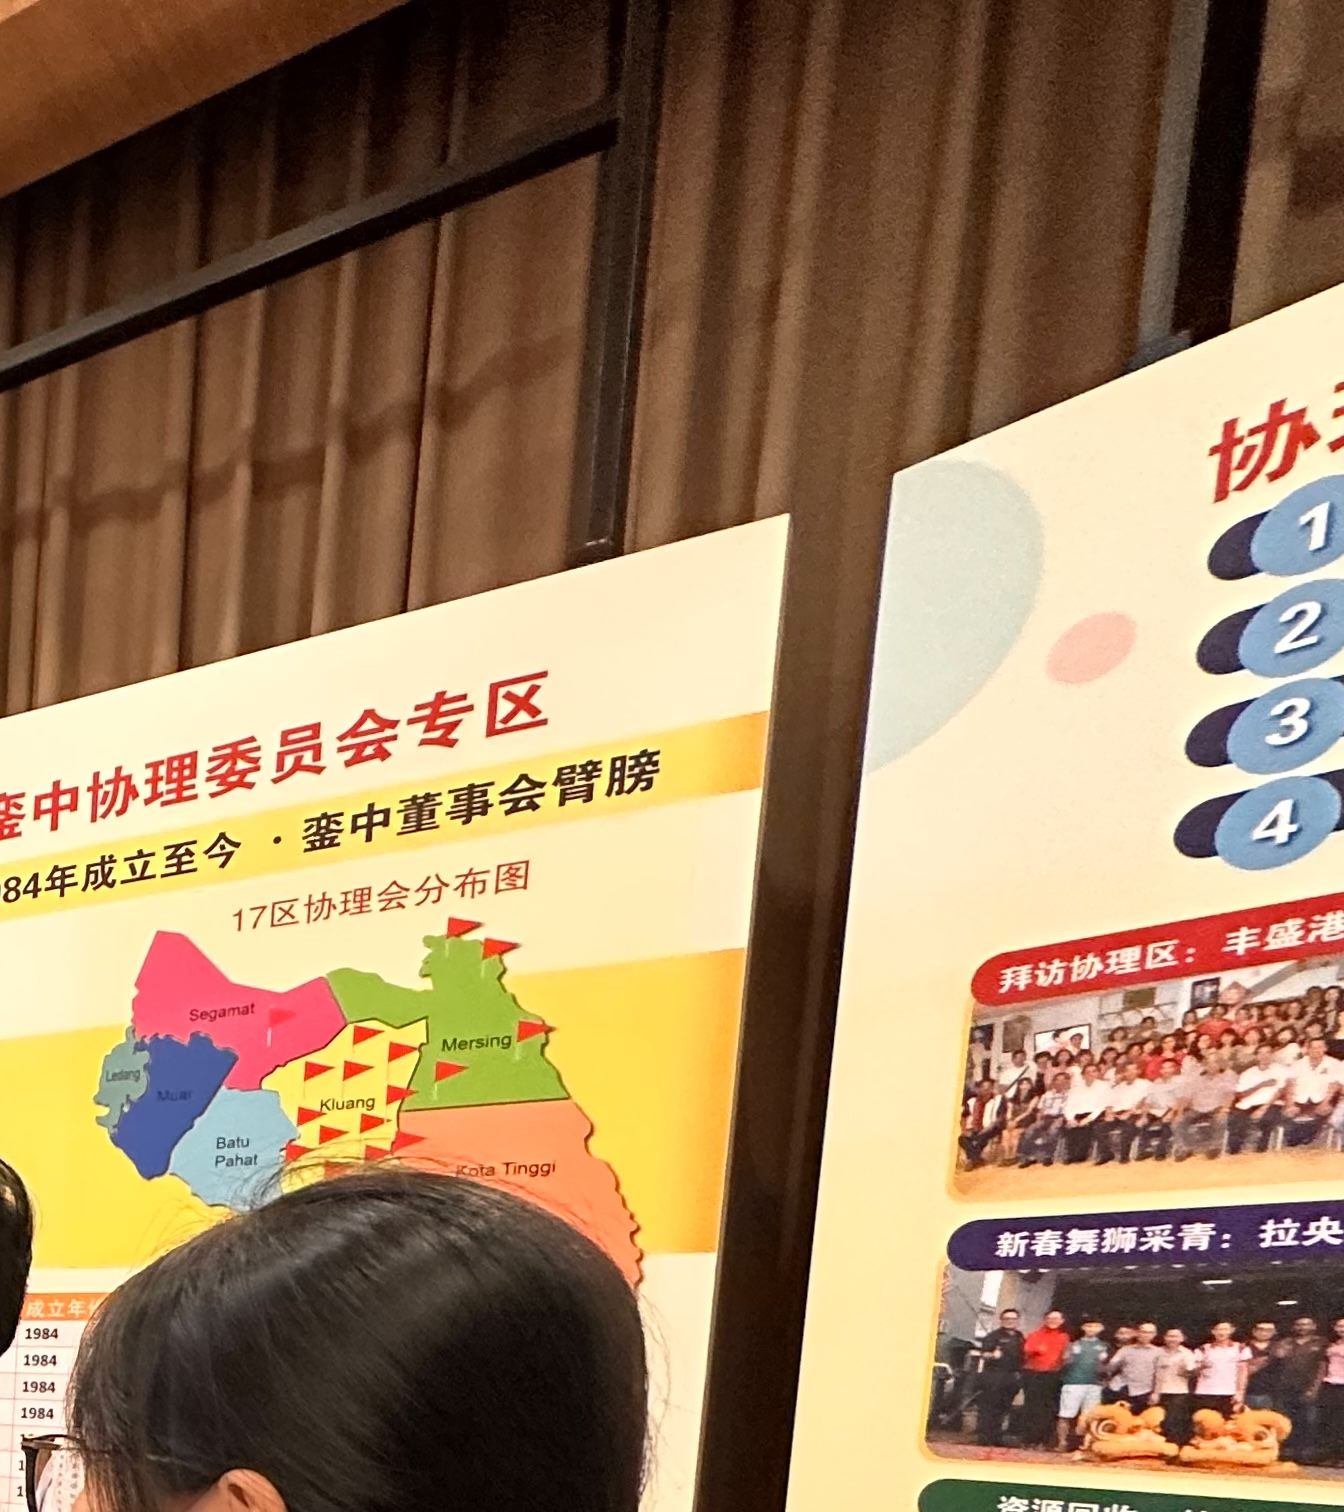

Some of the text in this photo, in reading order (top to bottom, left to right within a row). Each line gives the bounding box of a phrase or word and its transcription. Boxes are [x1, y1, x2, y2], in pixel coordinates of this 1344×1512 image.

[1207, 380, 1344, 503] 协
[1298, 501, 1330, 551] 1
[1274, 601, 1322, 653] 2
[1264, 696, 1310, 747] 3
[302, 748, 661, 855] 銮中董事会臂膀
[1252, 798, 1298, 845] 4
[232, 858, 531, 933] 17区协理会分布图
[189, 1001, 255, 1022] Segamat
[441, 1034, 512, 1053] Mersing
[105, 1068, 141, 1083] Ledang
[156, 1089, 192, 1102] Muar
[319, 1096, 375, 1112] Kluang
[216, 1136, 250, 1150] Batu
[215, 1153, 258, 1168] Pahat
[456, 1161, 556, 1178] Kota Tinggi
[25, 1328, 58, 1340] 1984
[23, 1355, 57, 1367] 1984
[22, 1381, 56, 1393] 1984
[20, 1407, 54, 1419] 1984
